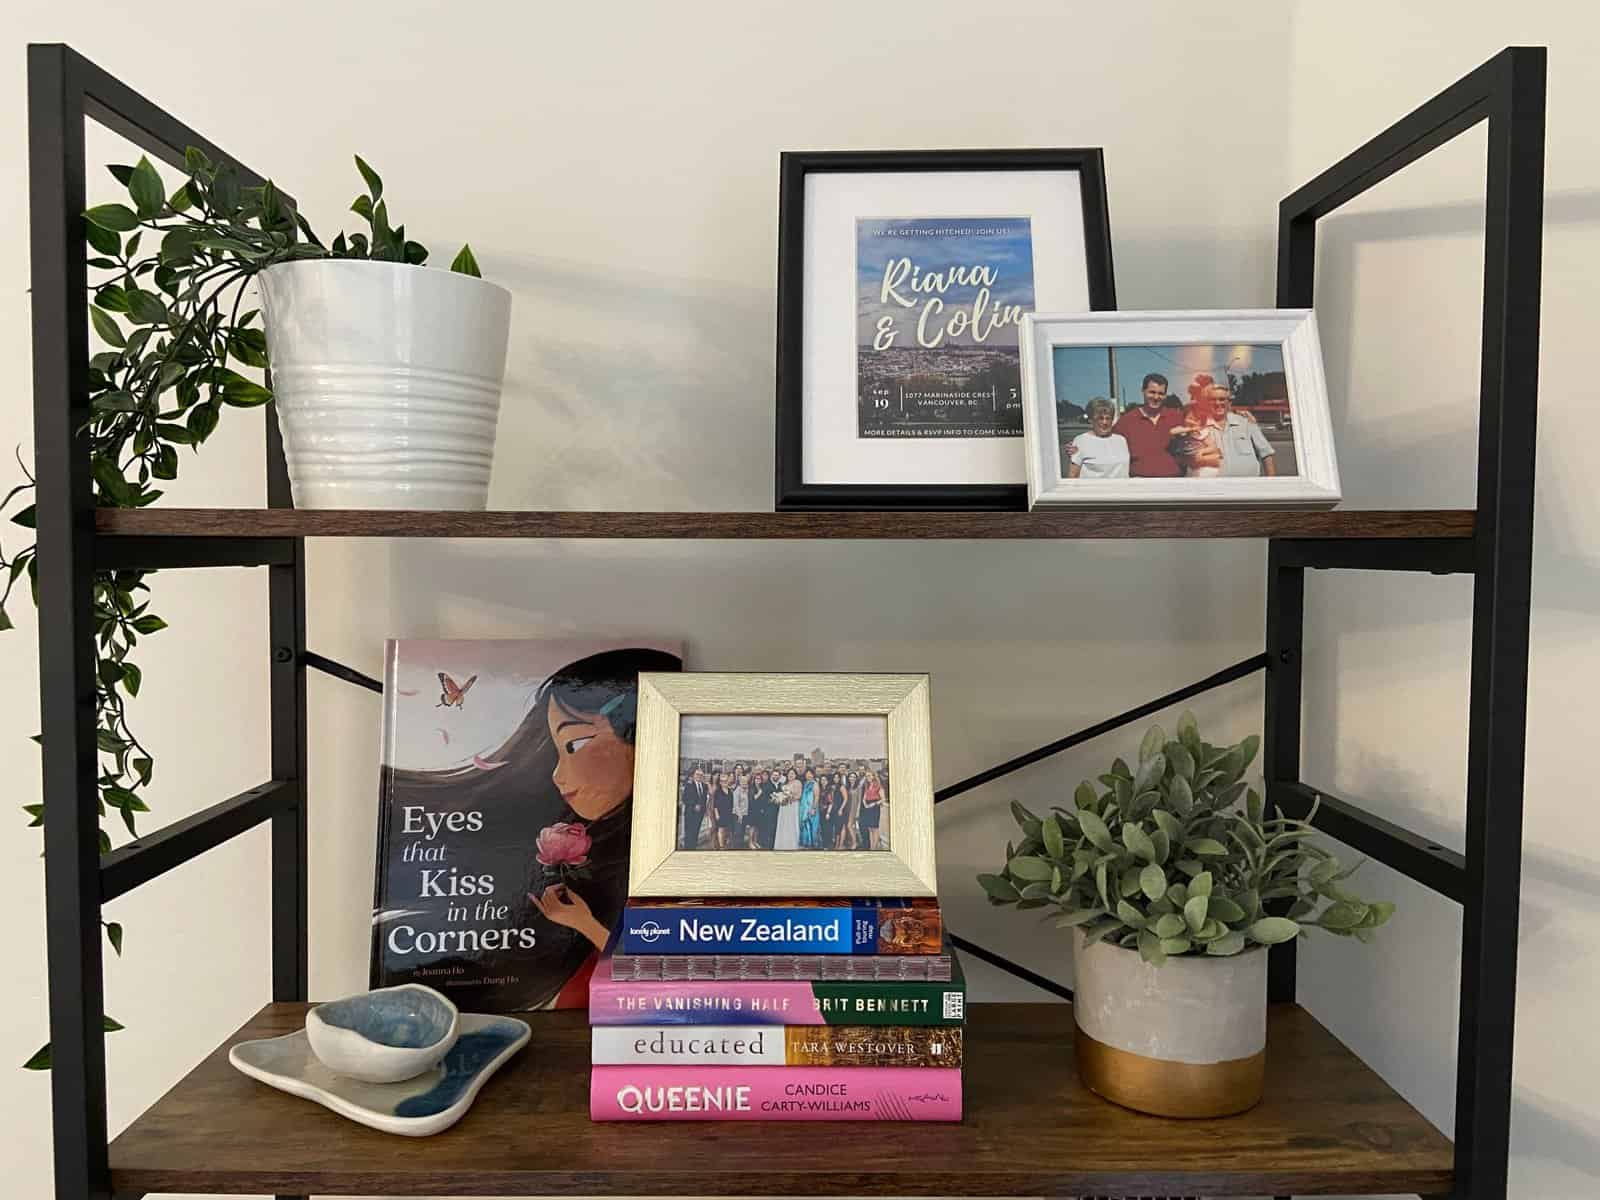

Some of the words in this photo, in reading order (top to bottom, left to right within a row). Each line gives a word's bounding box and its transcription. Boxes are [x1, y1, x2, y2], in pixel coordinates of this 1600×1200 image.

[899, 228, 935, 236] GETTING
[976, 228, 995, 236] JOIN
[881, 257, 998, 308] Riana
[873, 316, 899, 351] &
[917, 287, 1023, 349] Colin
[874, 398, 889, 409] 19
[401, 806, 483, 841] Eyes
[403, 841, 447, 863] that
[419, 867, 495, 898] Kiss
[447, 901, 468, 922] in
[475, 900, 508, 920] the
[388, 926, 536, 955] Corners
[630, 927, 649, 937] lonely
[650, 927, 671, 937] planet
[680, 919, 734, 941] New
[740, 918, 839, 941] Zealand
[617, 997, 647, 1010] THE
[654, 998, 742, 1010] VANISHING
[751, 998, 790, 1010] HALF
[814, 998, 848, 1011] BRIT
[855, 999, 928, 1012] BENNETT
[634, 1032, 764, 1054] educated
[792, 1042, 828, 1053] TARA
[835, 1043, 915, 1053] WESTOVER
[616, 1085, 752, 1114] QUEENIE
[785, 1084, 847, 1096] CANDICE
[761, 1101, 871, 1112] CARTY-WILLIAMS
